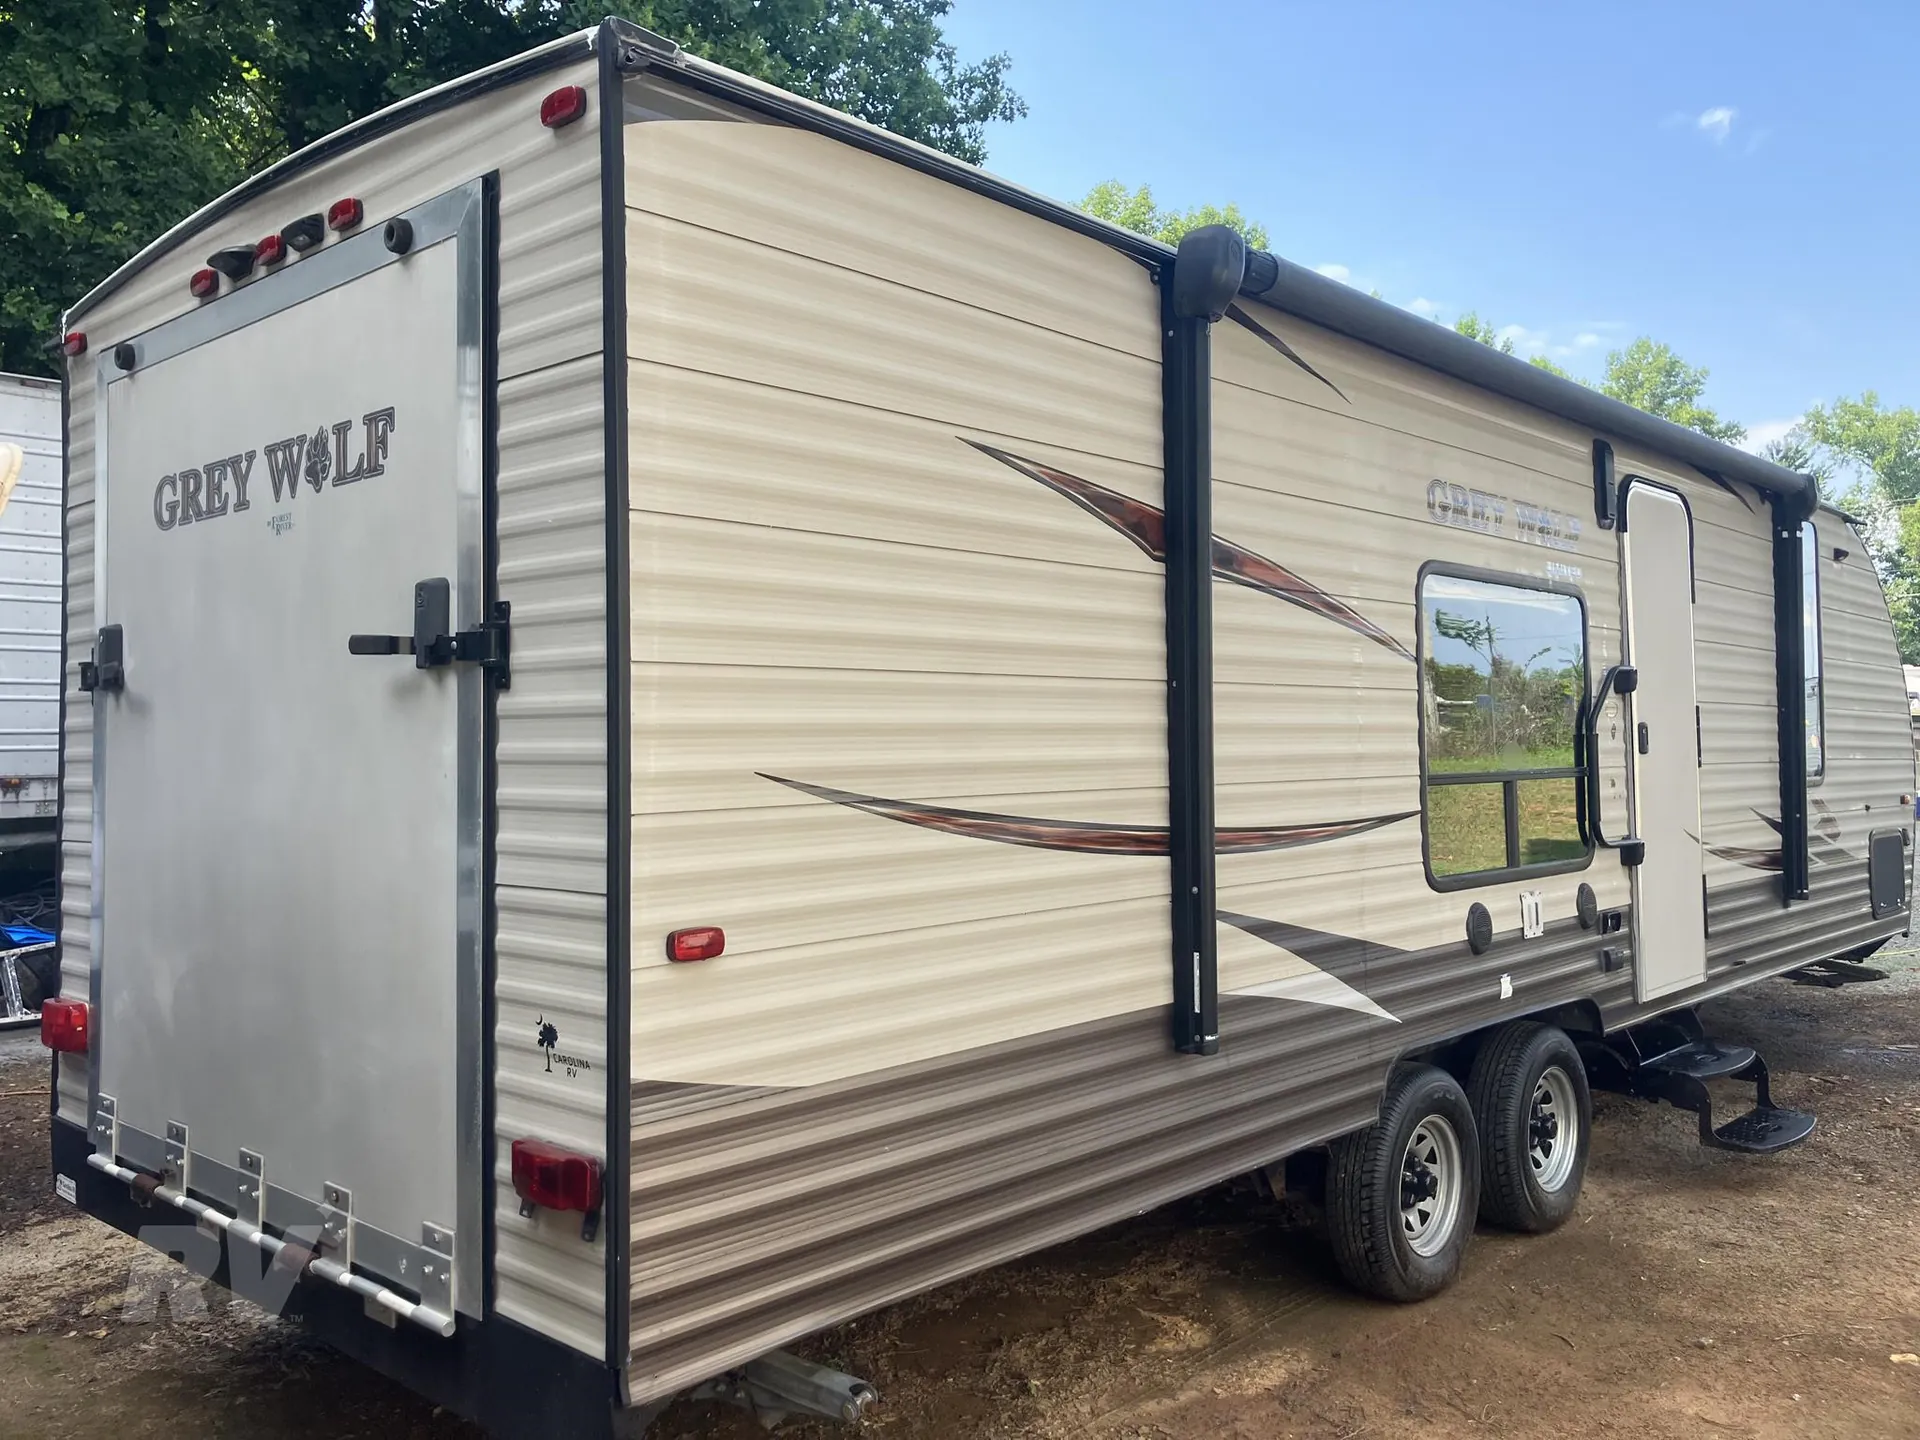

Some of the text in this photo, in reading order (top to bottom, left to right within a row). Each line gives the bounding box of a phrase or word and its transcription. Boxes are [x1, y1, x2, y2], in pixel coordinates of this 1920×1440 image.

[153, 449, 257, 531] GREY
[1426, 478, 1508, 535] GREY
[553, 1053, 591, 1070] CAROLINA
[566, 1067, 578, 1078] RV
